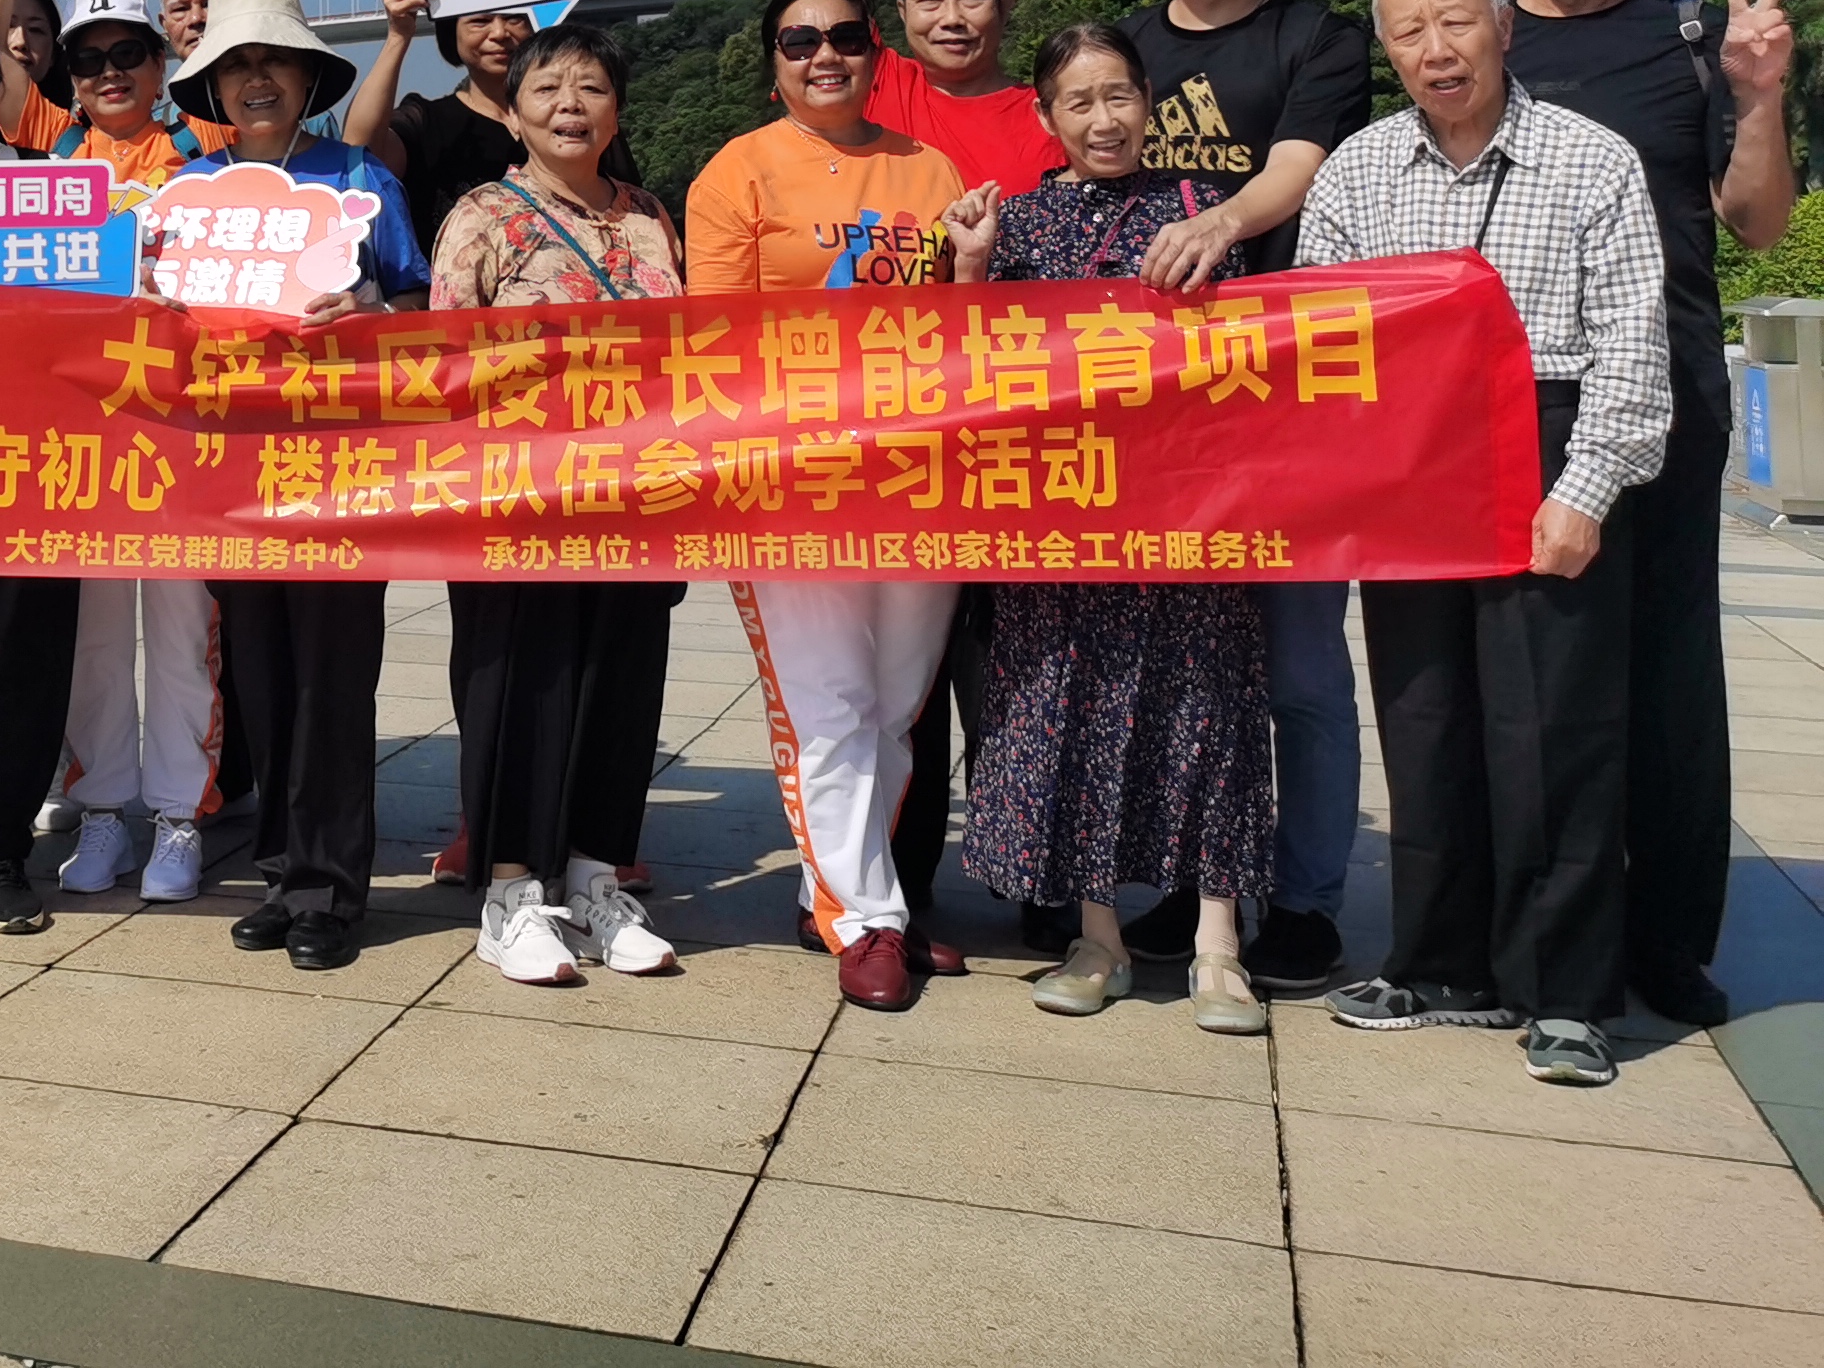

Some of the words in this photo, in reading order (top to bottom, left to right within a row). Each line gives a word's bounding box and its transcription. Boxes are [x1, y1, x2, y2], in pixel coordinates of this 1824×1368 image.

[1140, 134, 1253, 173] didas
[100, 286, 1379, 431] 大铲社区楼栋长增能培育项目
[4, 528, 363, 572] 大铲社区党群服务中心
[518, 890, 538, 900] NIKE
